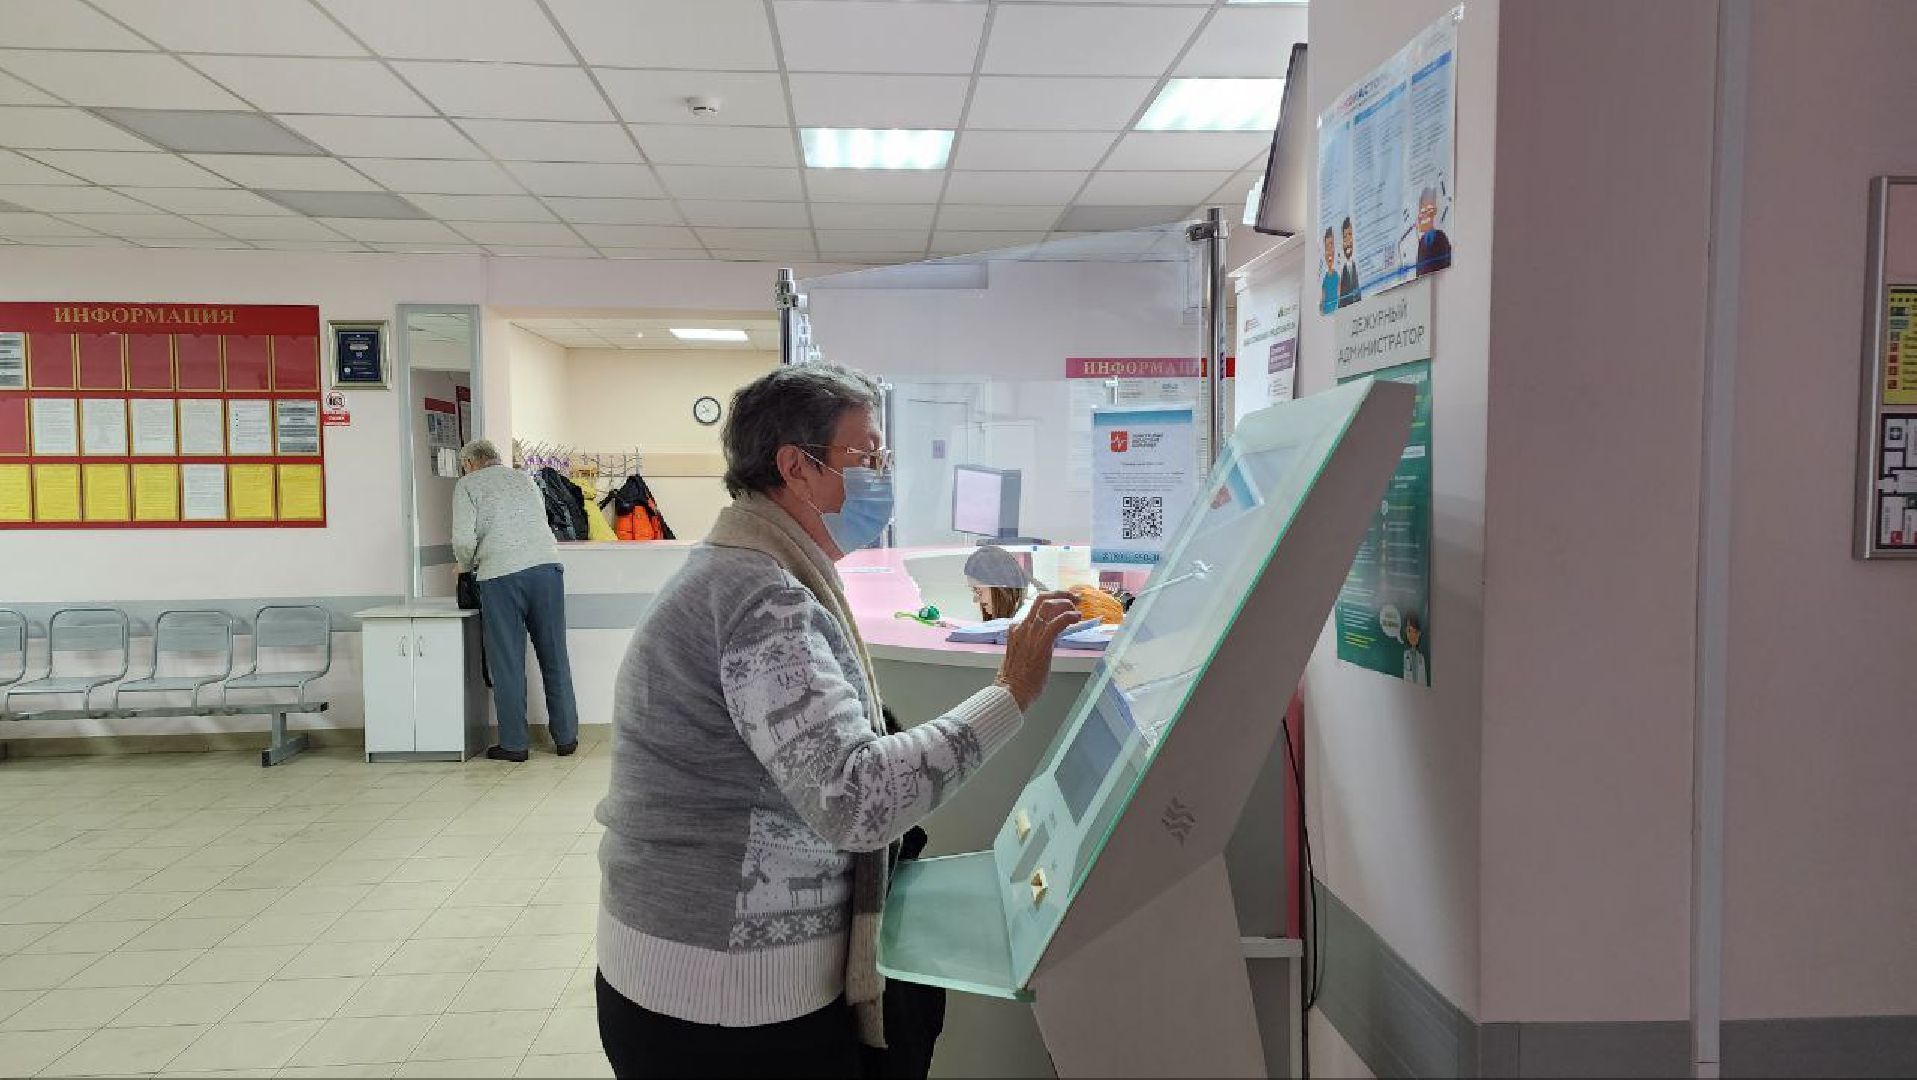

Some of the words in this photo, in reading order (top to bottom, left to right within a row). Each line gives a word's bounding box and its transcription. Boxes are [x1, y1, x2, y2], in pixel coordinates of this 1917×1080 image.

[54, 307, 236, 325] ИНФОРМАЦИЯ
[1351, 298, 1408, 337] ДЕЖУРНЫЙ
[1337, 325, 1425, 363] АДМИНИСТРАТОР
